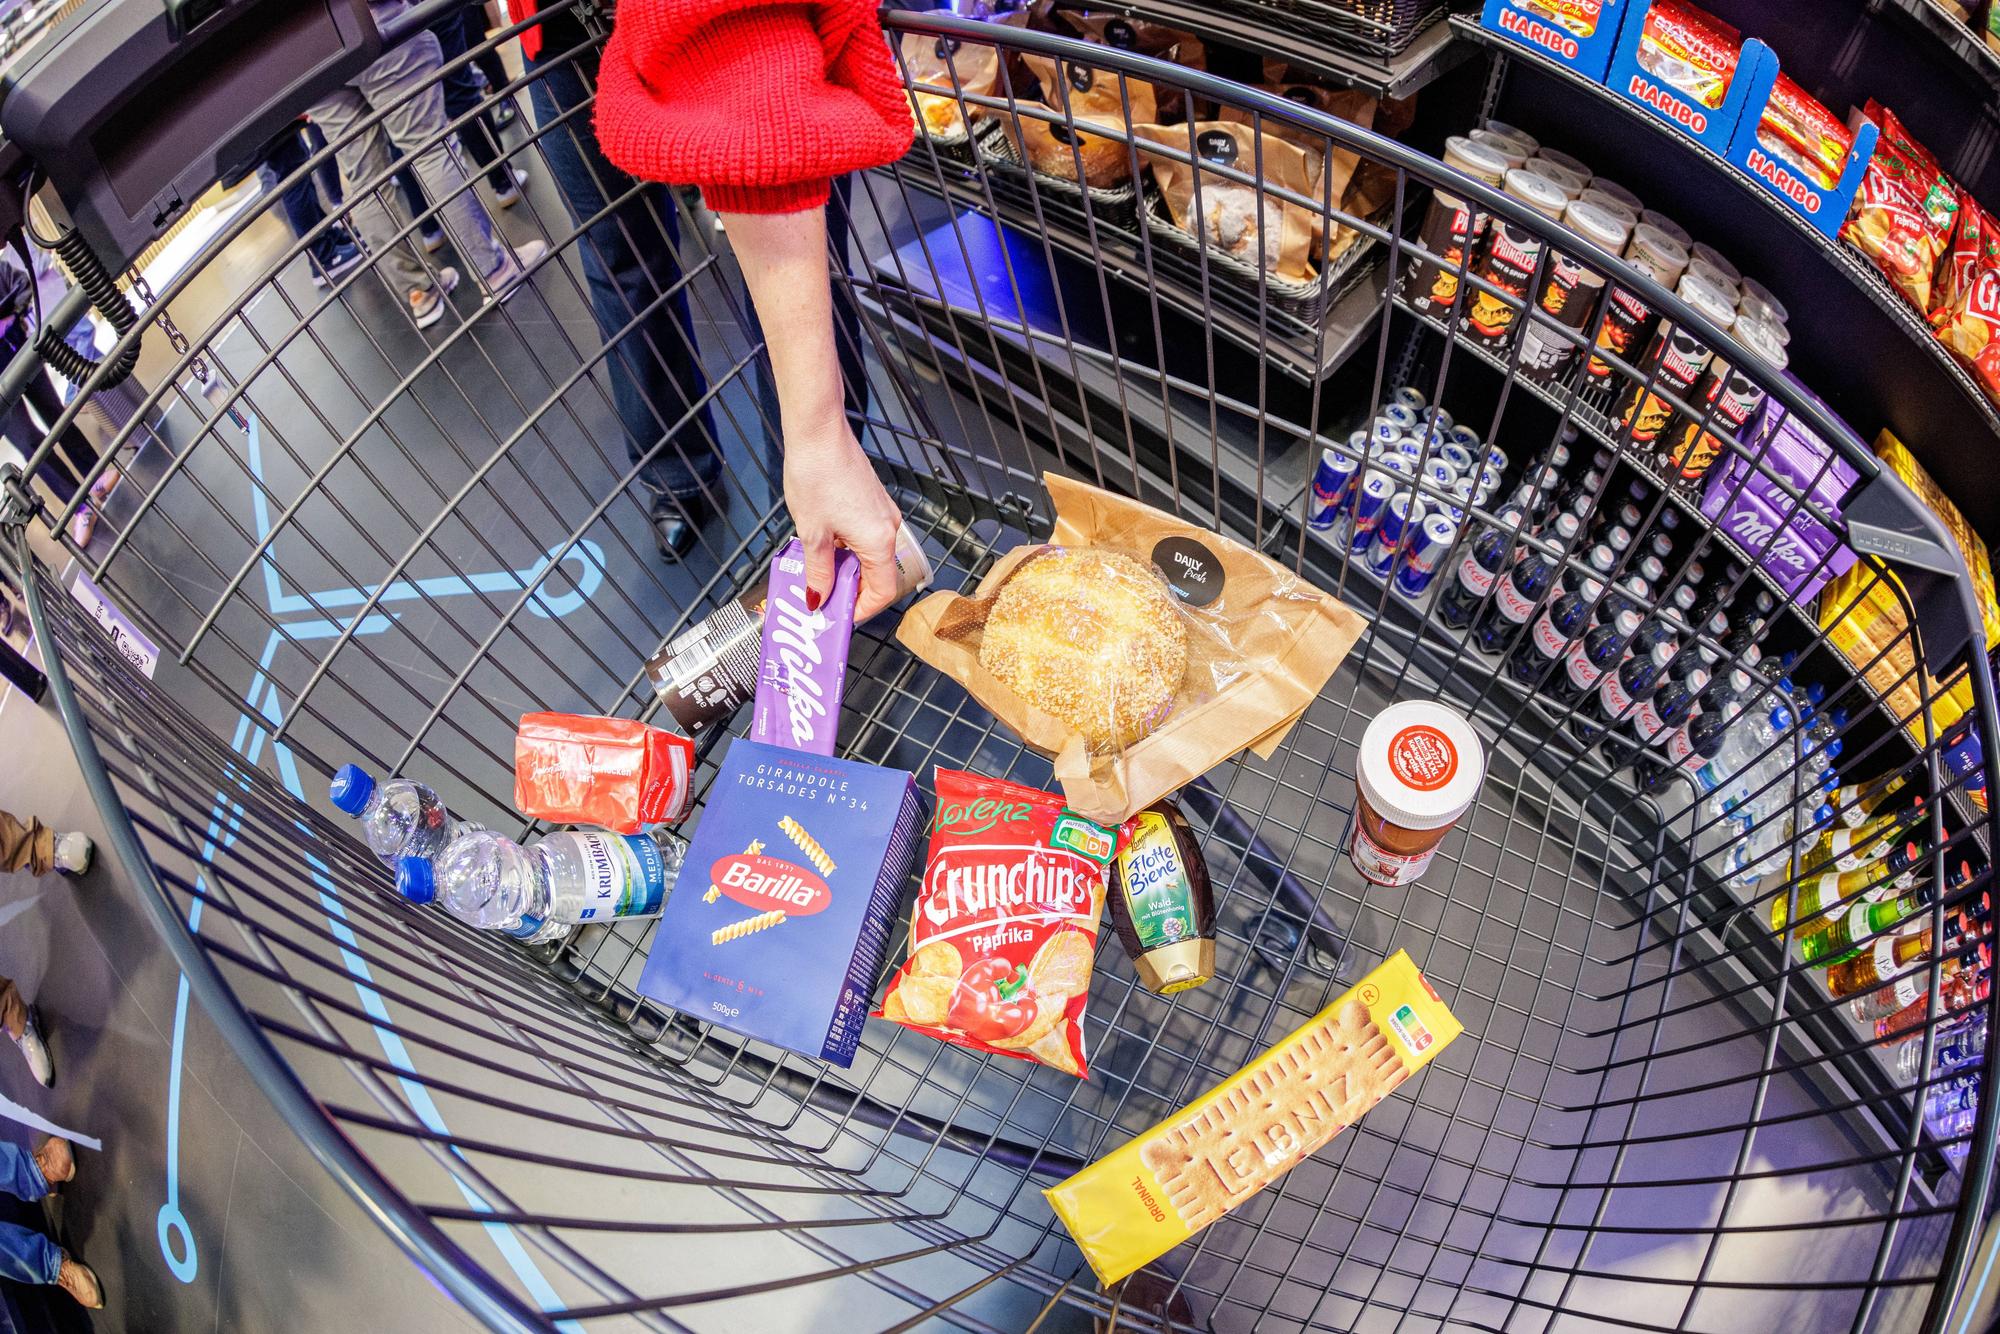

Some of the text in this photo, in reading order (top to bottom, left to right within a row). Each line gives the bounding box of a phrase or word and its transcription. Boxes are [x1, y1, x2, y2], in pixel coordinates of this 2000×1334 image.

[1562, 3, 1582, 17] Cola
[1499, 8, 1579, 59] HARIBO
[1629, 75, 1707, 134] HARIBO
[1746, 149, 1822, 214] HARIBO
[1894, 214, 1920, 232] Paprika
[1491, 232, 1538, 273] PRINGLES
[1491, 258, 1505, 270] HOT
[1509, 267, 1529, 279] SPICY
[1733, 510, 1806, 571] Milka
[1174, 552, 1203, 571] DAILY
[1183, 567, 1208, 584] fresh
[772, 584, 826, 748] Milka
[757, 764, 849, 792] GIRANDOLE
[1428, 760, 1439, 777] XXL
[738, 773, 817, 799] TORSADES
[935, 796, 1033, 835] Lorenz
[584, 833, 612, 899] KRUMBACH
[638, 839, 657, 883] MEDIUM
[756, 857, 773, 867] DAL
[1128, 845, 1175, 874] Flotte
[721, 861, 816, 907] Barilla
[924, 854, 1086, 927] Crunchips
[1128, 859, 1177, 896] Biene
[1141, 904, 1185, 921] mit Blütenhonig
[1147, 898, 1175, 912] Wald-
[973, 928, 1034, 953] Paprika
[736, 979, 745, 992] 6
[712, 1001, 731, 1017] 500g
[1206, 1070, 1363, 1196] LEIBNIZ
[1133, 1174, 1167, 1224] ORIGINAL
